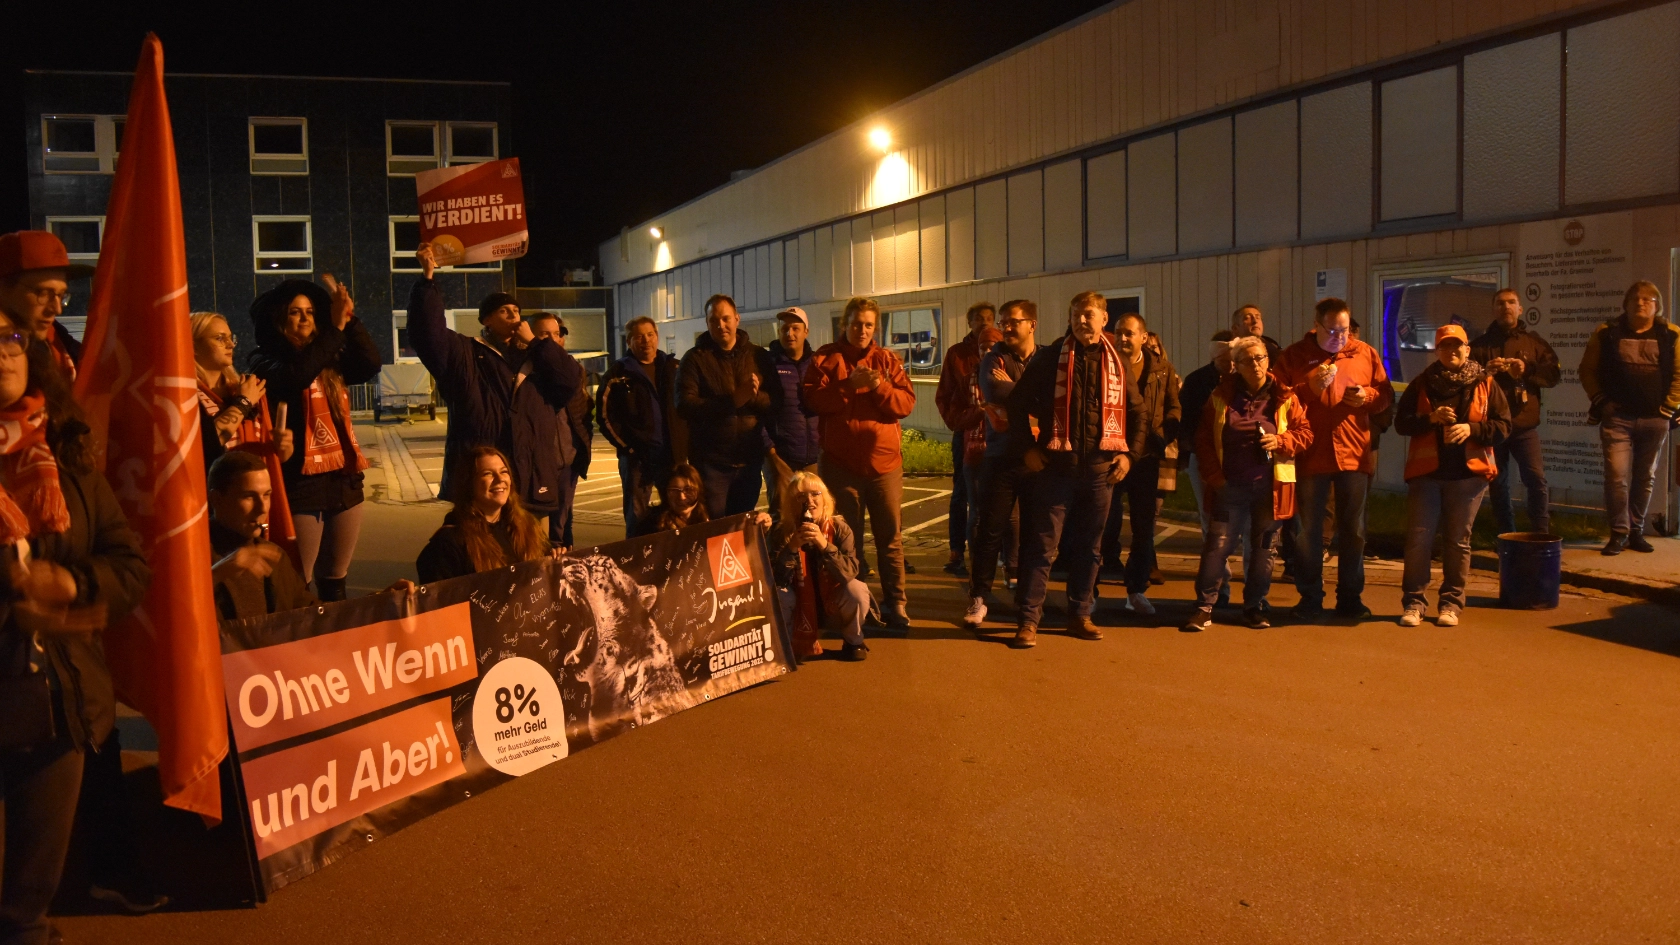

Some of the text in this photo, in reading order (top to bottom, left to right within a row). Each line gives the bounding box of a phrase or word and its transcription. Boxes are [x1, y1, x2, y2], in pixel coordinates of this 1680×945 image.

[422, 194, 504, 214] WIR HABEN ES
[423, 203, 522, 229] VERDIENT!
[1565, 228, 1583, 239] STOP
[1526, 253, 1554, 261] Anweisung
[1564, 250, 1573, 258] das
[1574, 249, 1600, 257] Verhalten
[1555, 259, 1585, 267] Lieferanten
[1592, 256, 1625, 265] Speditionen
[1550, 282, 1596, 292] Fotografierverbot
[1558, 291, 1584, 300] gesamten
[1529, 311, 1537, 321] 15
[1550, 306, 1612, 316] Höchstgeschwindigkeit
[1550, 317, 1575, 325] gesamten
[1569, 331, 1578, 339] auf
[1579, 331, 1589, 339] den
[1546, 418, 1571, 427] Fahrzeug
[708, 628, 762, 657] SOLIDARITÄT
[711, 662, 751, 681] TARIFBEWEGUNG
[751, 657, 764, 668] 2022
[238, 635, 469, 729] Ohne Wenn
[494, 683, 540, 724] 8%
[494, 725, 522, 742] mehr
[523, 718, 547, 734] Geld
[497, 735, 551, 754] für Auszubildende
[495, 755, 508, 765] und
[508, 751, 522, 760] dual
[251, 720, 453, 838] und Aber!
